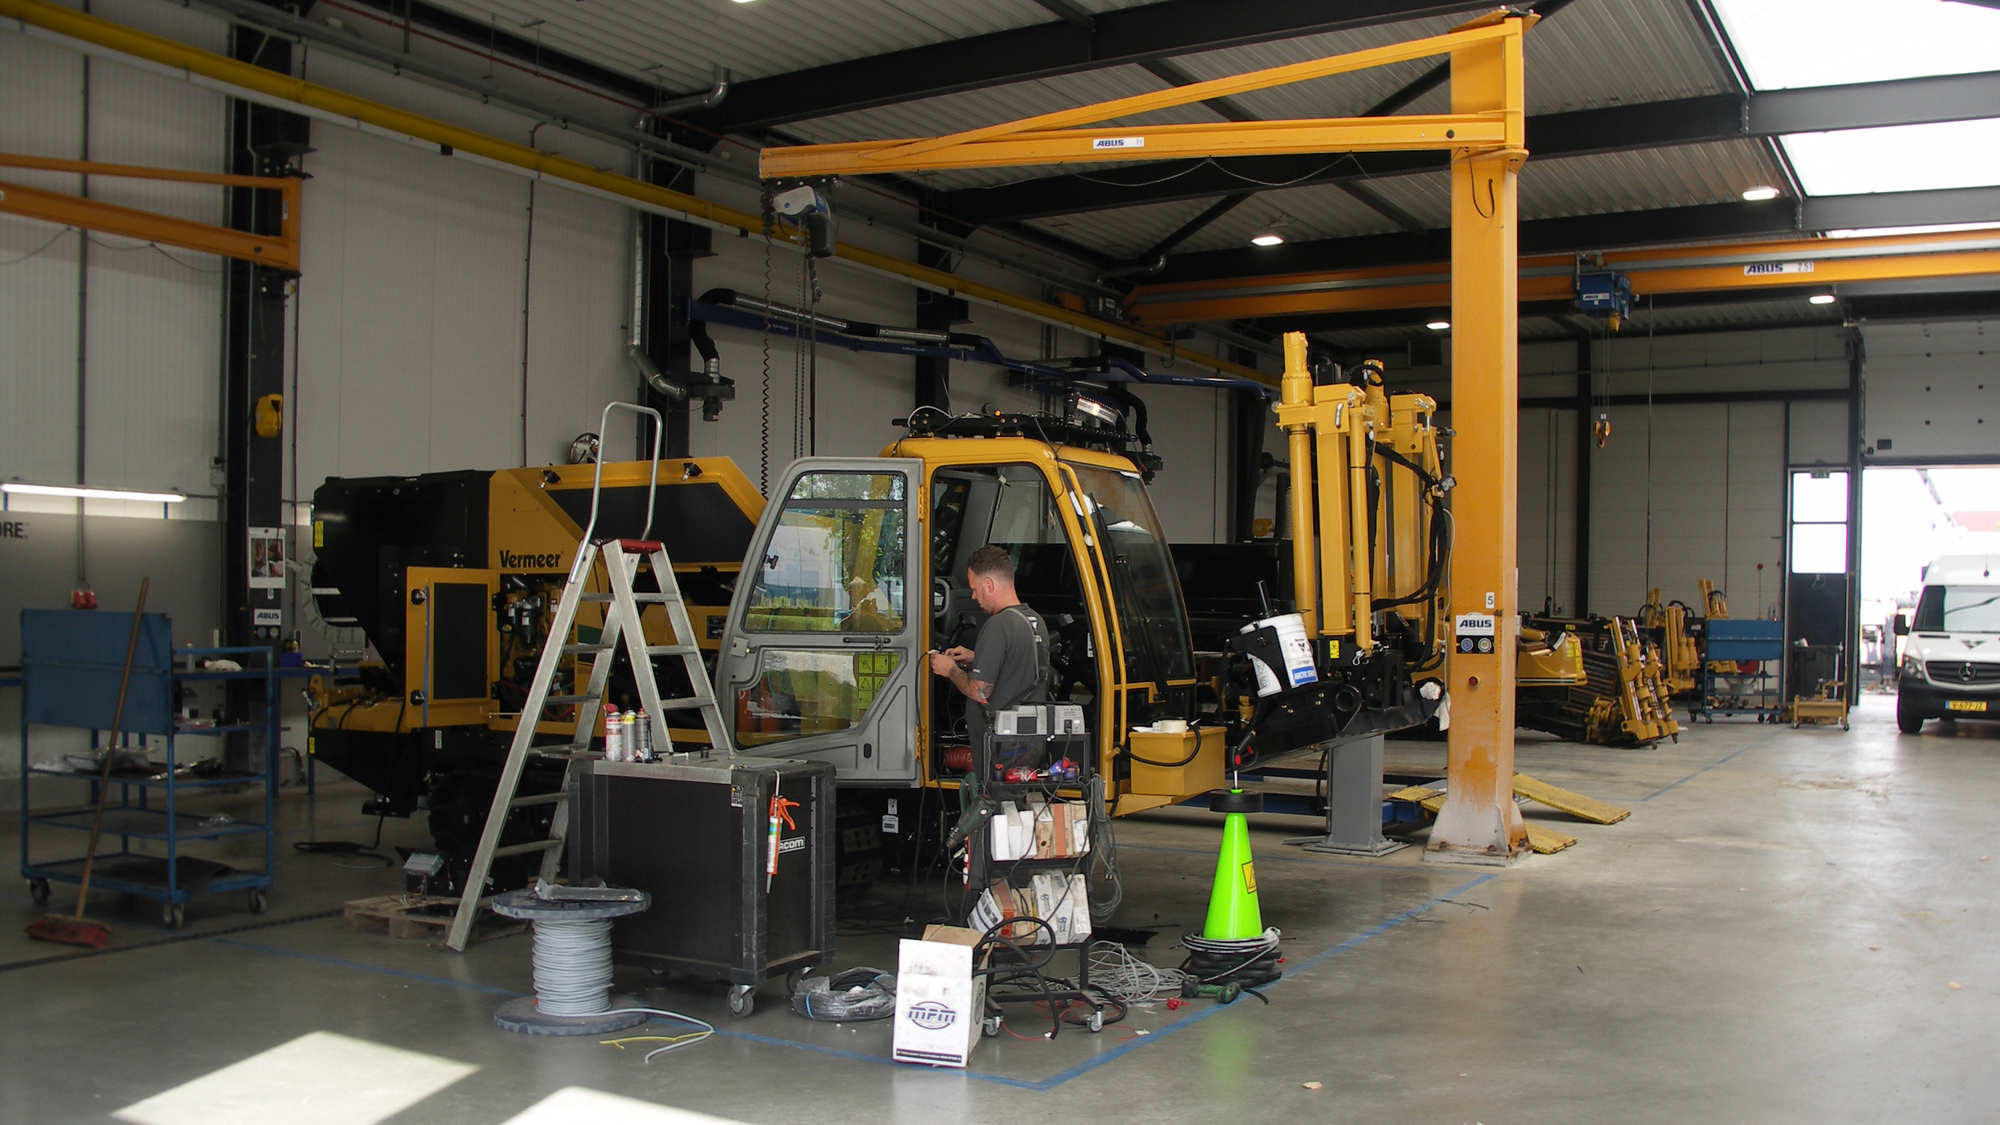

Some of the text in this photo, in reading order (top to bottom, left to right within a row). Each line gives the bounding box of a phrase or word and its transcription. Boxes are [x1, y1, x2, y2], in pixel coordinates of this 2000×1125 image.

[1096, 139, 1125, 147] ABUS
[1745, 263, 1784, 275] ABUS
[499, 549, 562, 568] Vermeer
[1487, 595, 1494, 606] 5
[1459, 619, 1492, 628] ABUS
